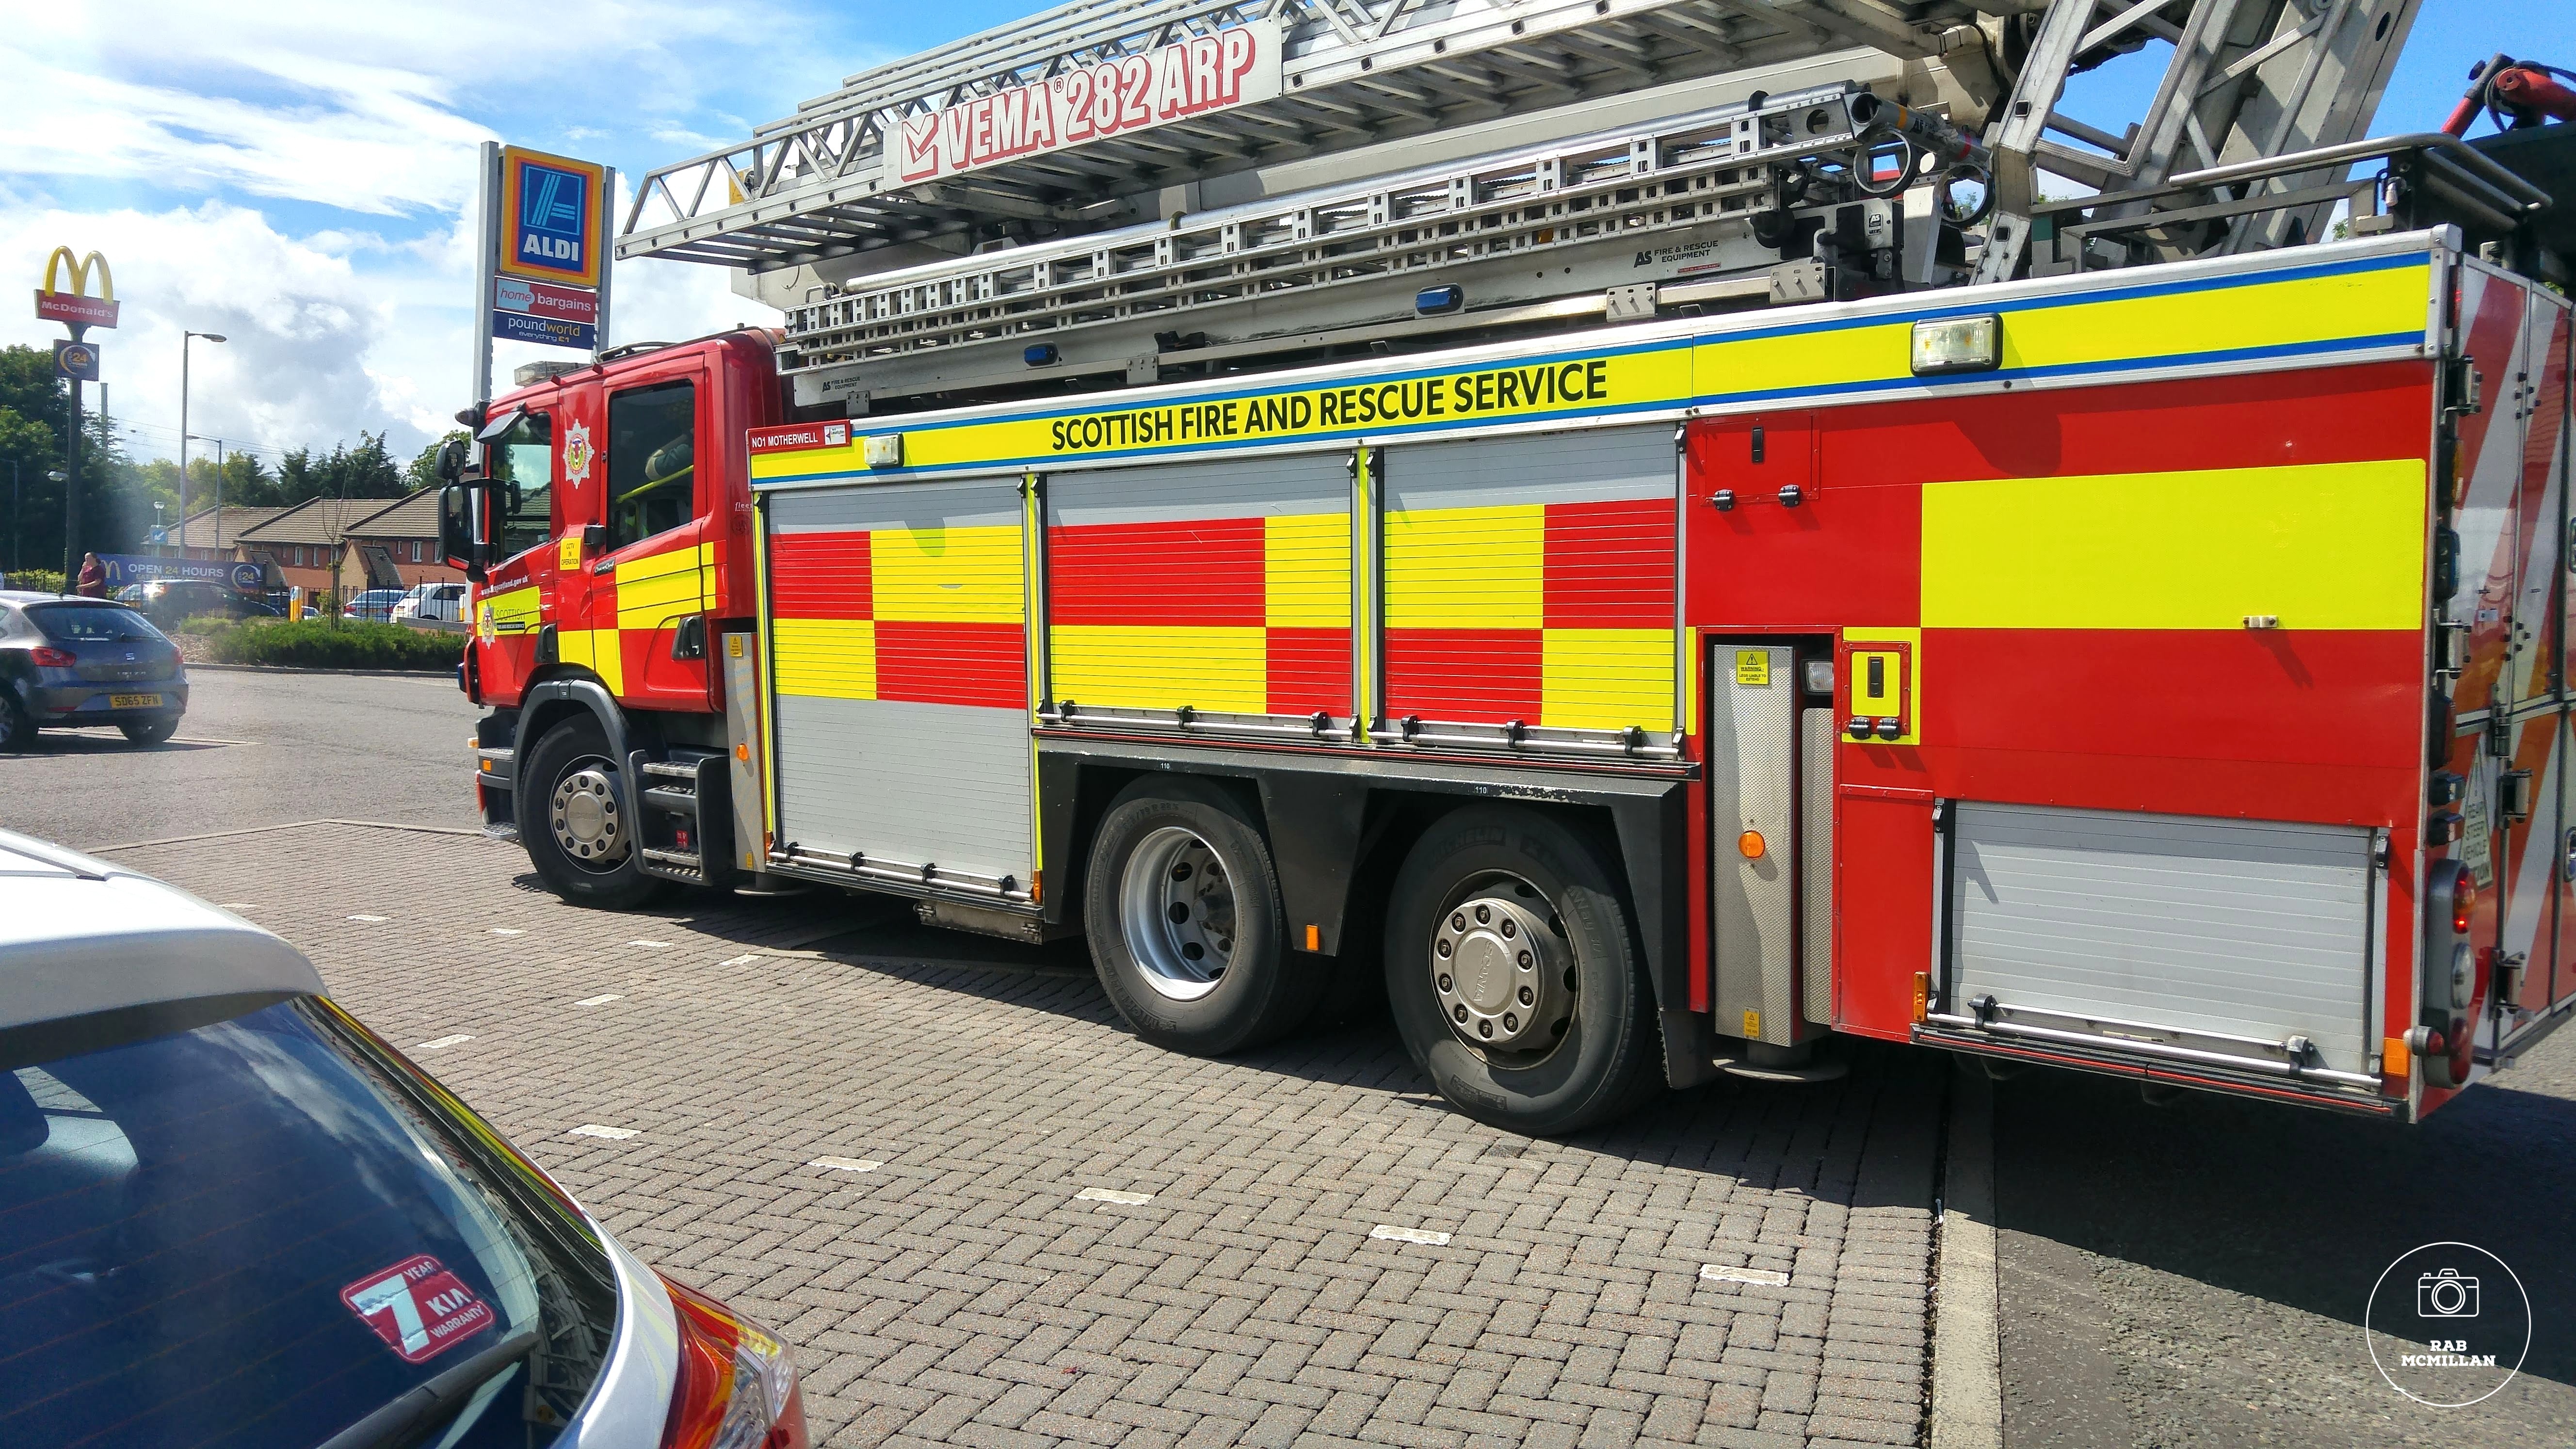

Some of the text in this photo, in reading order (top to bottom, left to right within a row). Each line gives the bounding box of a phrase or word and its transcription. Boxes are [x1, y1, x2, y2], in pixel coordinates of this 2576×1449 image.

[1067, 55, 1151, 143] 282
[1159, 28, 1256, 119] ARP
[523, 234, 579, 262] ALDI
[1633, 250, 1652, 268] AS
[1654, 246, 1673, 256] FIRE
[1683, 240, 1719, 252] RESCUE
[1661, 249, 1711, 263] EQUIPMENT
[500, 287, 592, 311] home bargains
[42, 301, 113, 318] McDonald's
[508, 317, 580, 337] poundworld
[518, 331, 557, 342] everything
[72, 352, 87, 363] 24
[822, 381, 831, 393] AS
[835, 382, 857, 390] EQUIPMENT
[1052, 360, 1607, 451] SCOTTISH FIRE AND RESCUE SERVICE
[752, 432, 819, 448] NO1 MOTHERWELL
[128, 564, 224, 578] OPEN 24 HOURS
[242, 572, 255, 580] 24
[114, 695, 140, 706] SD65
[2466, 821, 2484, 841] STEER
[1473, 940, 1494, 1002] SCANIA
[348, 1261, 437, 1355] 7 YEAR
[425, 1288, 472, 1317] KIA
[430, 1304, 485, 1338] WARRANTY
